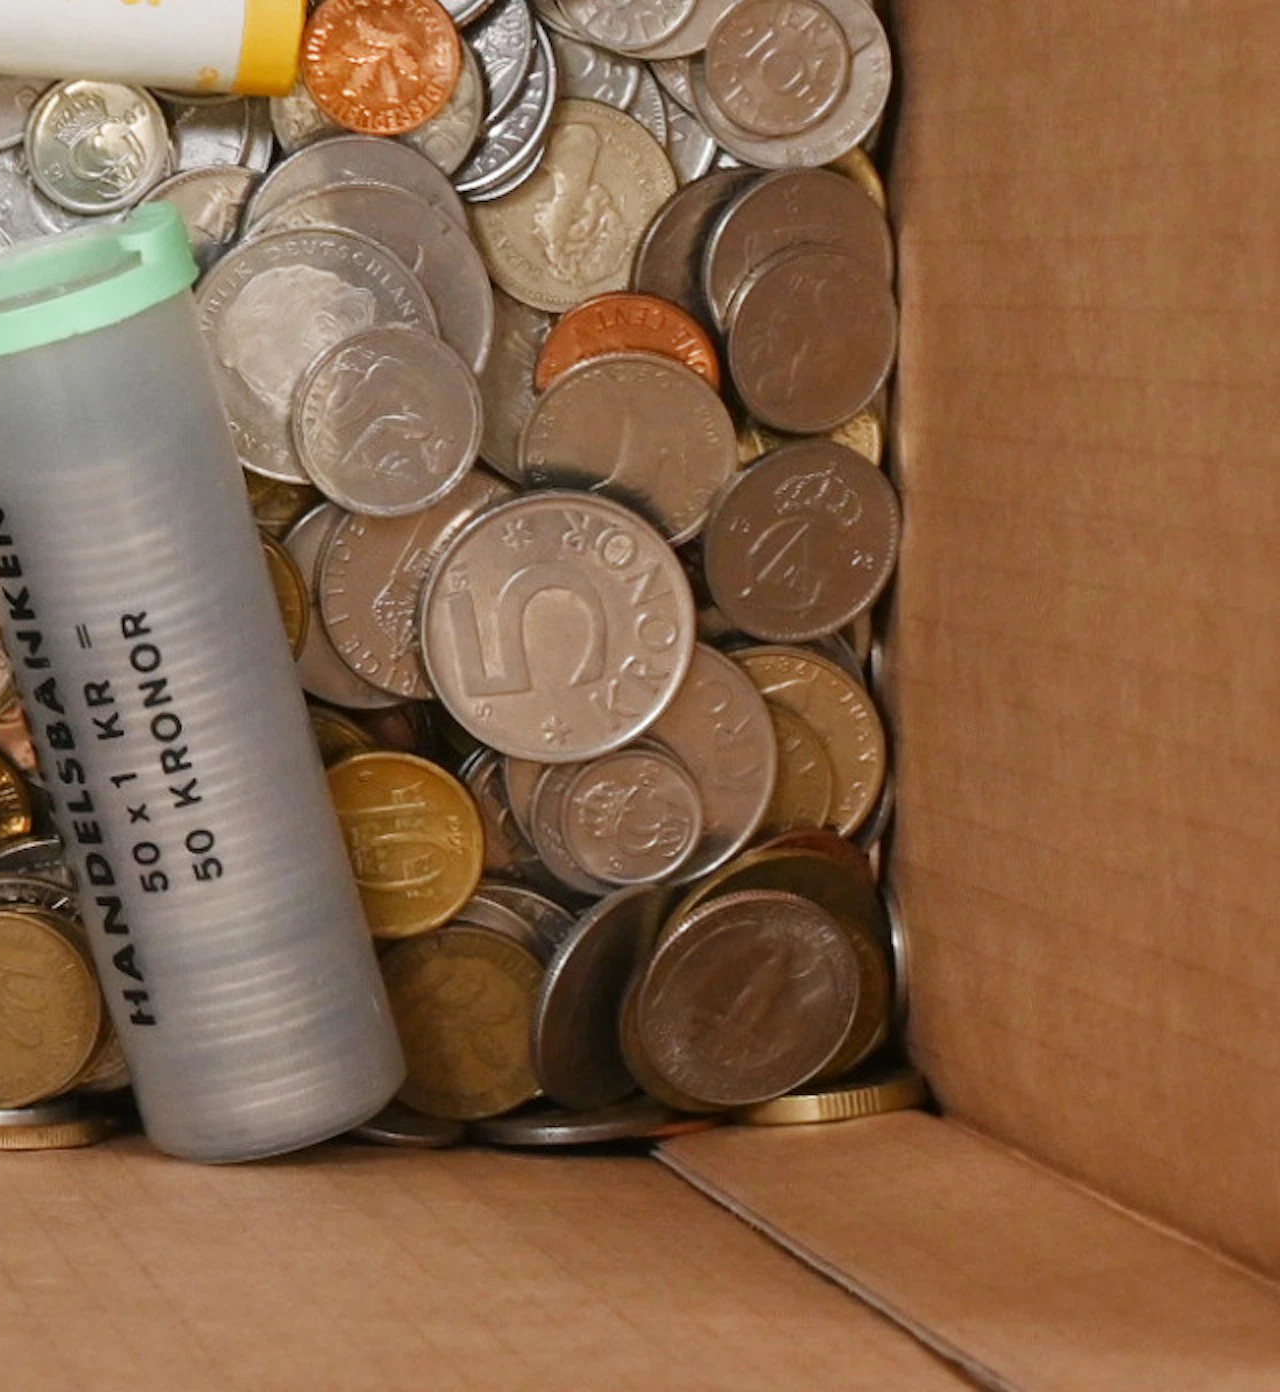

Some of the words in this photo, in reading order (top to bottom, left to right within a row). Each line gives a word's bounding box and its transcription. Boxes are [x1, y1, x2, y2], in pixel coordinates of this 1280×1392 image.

[442, 562, 606, 698] 5
[560, 506, 680, 720] KRONOR
[83, 678, 126, 743] KR
[122, 607, 203, 809] KRONOR
[138, 843, 171, 895] 50
[186, 827, 224, 884] 50
